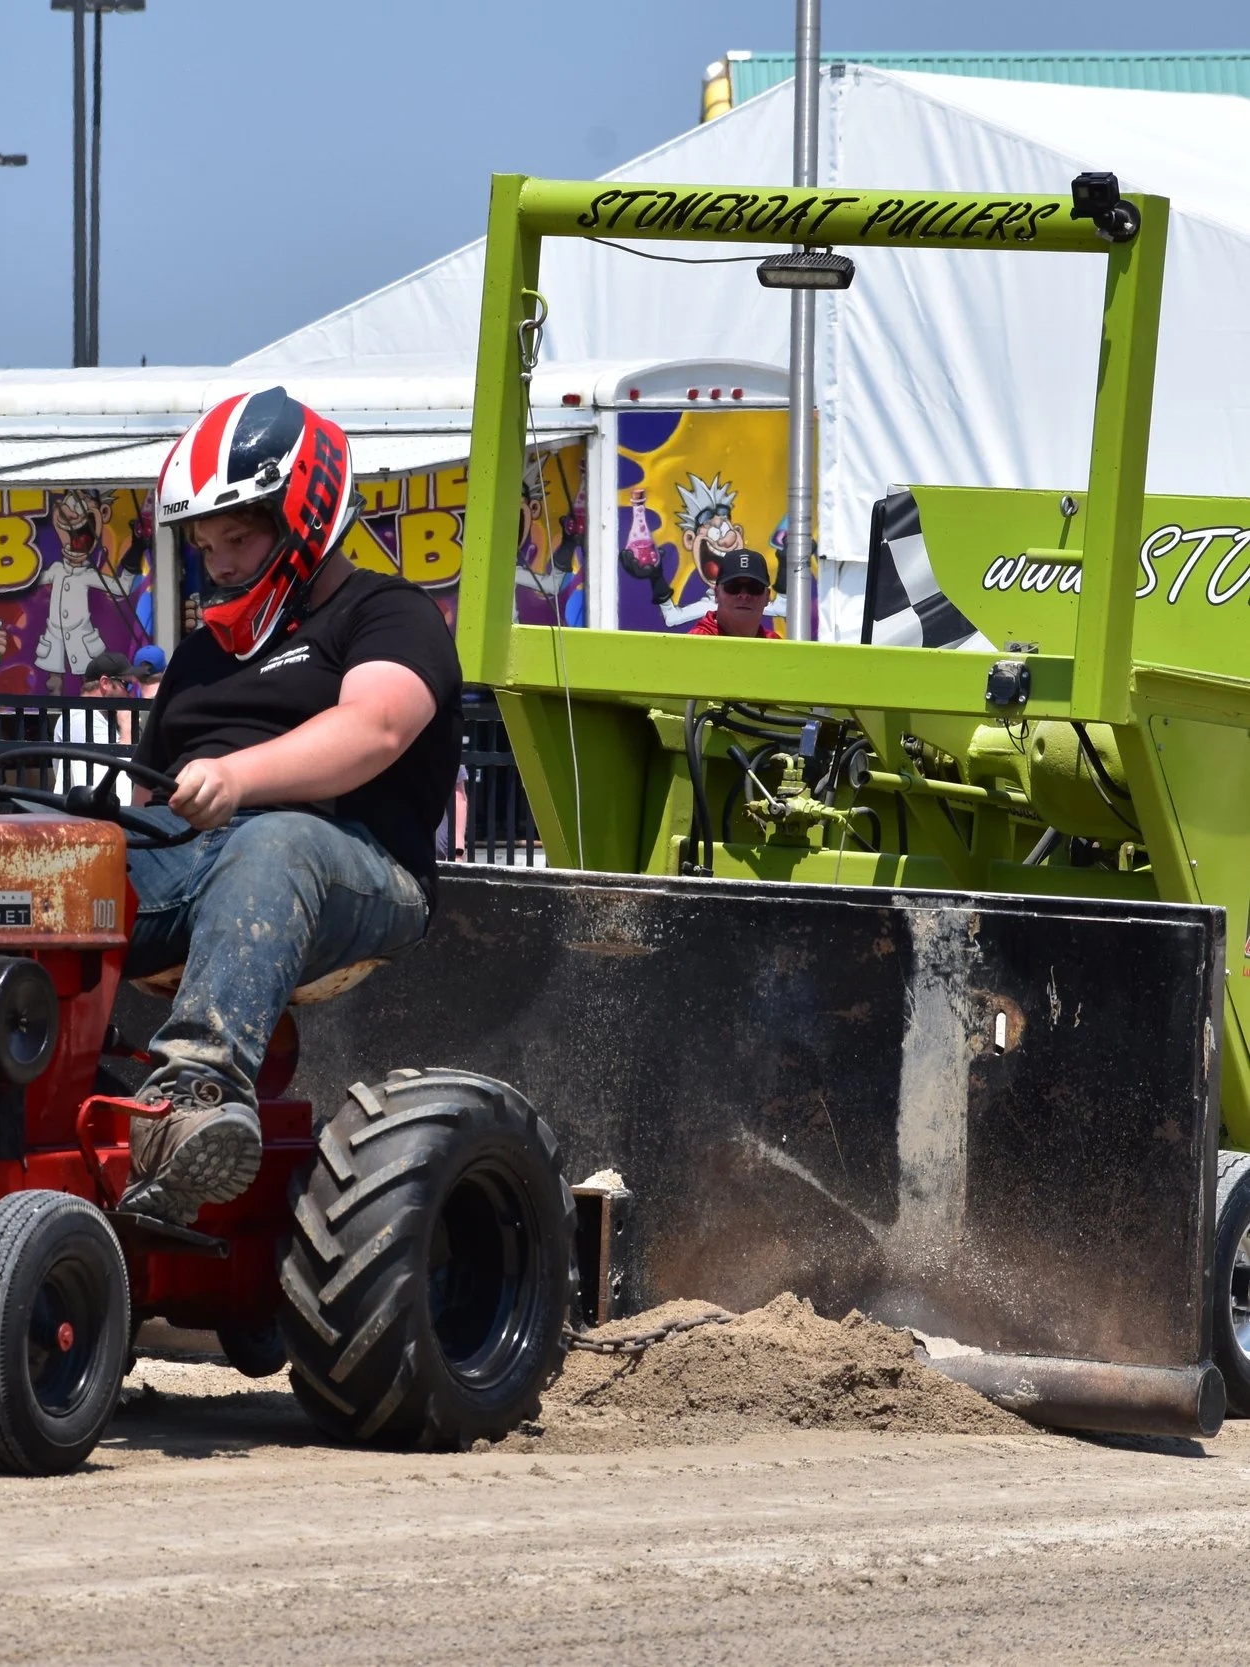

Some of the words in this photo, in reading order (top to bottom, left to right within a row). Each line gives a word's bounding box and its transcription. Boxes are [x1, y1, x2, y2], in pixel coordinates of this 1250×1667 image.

[577, 190, 860, 236] STONEBOAT
[860, 199, 1060, 242] PULLERS
[163, 500, 189, 515] THOR
[270, 428, 343, 586] THOR
[341, 511, 463, 588] AB
[93, 899, 115, 928] 100
